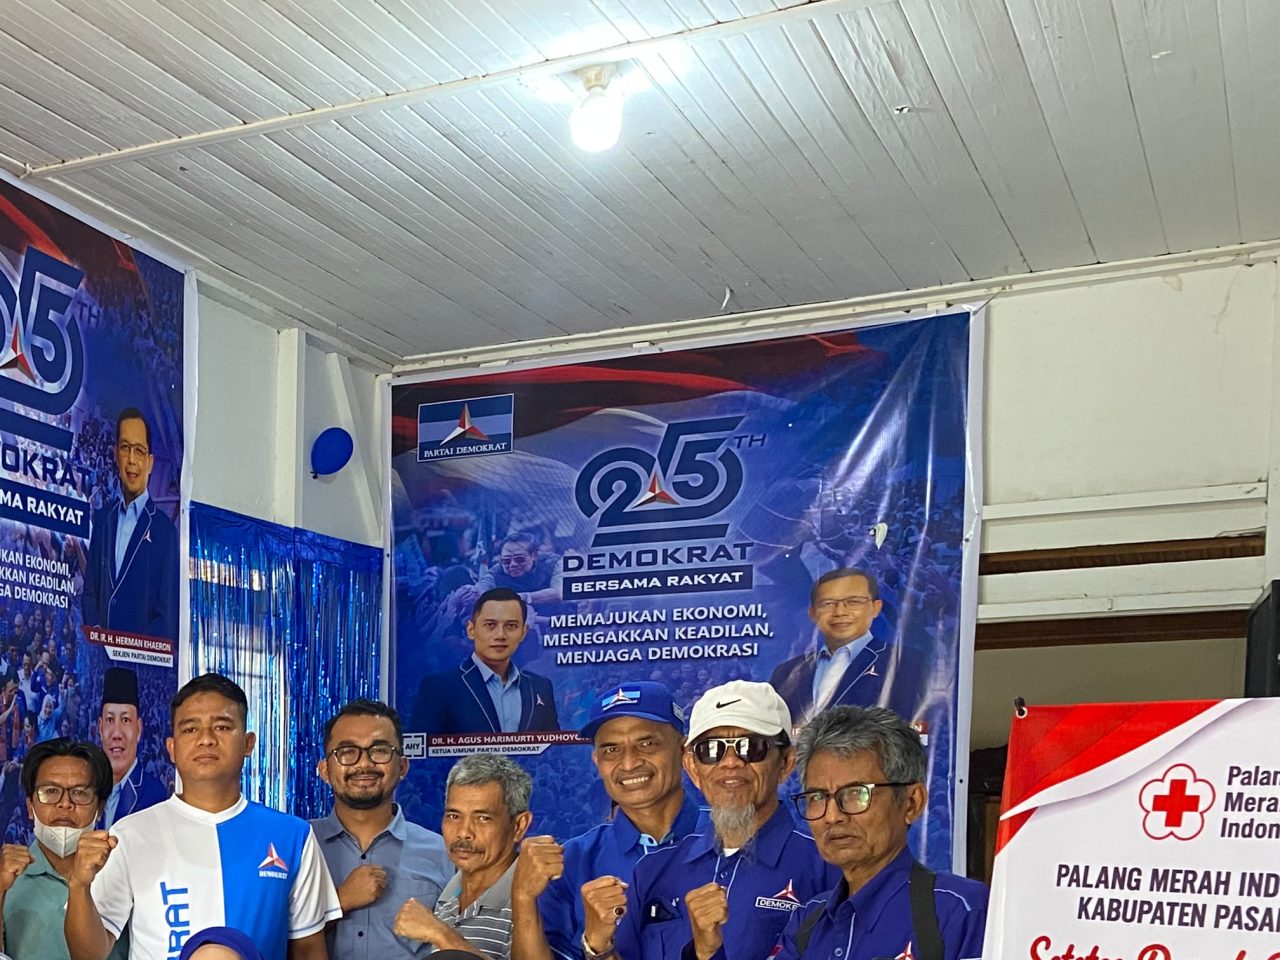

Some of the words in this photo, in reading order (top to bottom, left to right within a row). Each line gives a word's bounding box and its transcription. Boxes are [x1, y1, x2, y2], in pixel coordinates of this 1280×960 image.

[423, 445, 454, 459] PARTAI
[455, 442, 508, 457] DEMOKRAT
[26, 494, 84, 527] RAKYAT
[25, 555, 72, 580] EKONOMI,
[562, 541, 755, 574] DEMOKRAT
[28, 572, 77, 597] KEADILAN,
[570, 575, 662, 594] BERSAMA
[666, 571, 745, 589] RAKYAT
[14, 585, 69, 609] DEMOKRASI
[549, 608, 666, 629] MEMAJUKAN
[672, 603, 769, 624] EKONOMI,
[115, 636, 143, 648] HERMAN
[144, 640, 172, 652] KHAERON
[542, 626, 669, 648] MENEGAKKAN
[674, 621, 775, 643] KEADILAN,
[556, 646, 643, 665] MENJAGA
[647, 642, 760, 661] DEMOKRASI
[405, 742, 420, 751] AHY
[432, 737, 445, 746] DR.
[447, 737, 457, 745] H.
[458, 736, 482, 745] AGUS
[483, 734, 535, 744] HARIMURTI
[501, 744, 541, 753] DEMOKRAT
[1224, 792, 1280, 813] Mera
[1057, 864, 1141, 892] PALANG
[1149, 868, 1231, 897] MERAH
[1077, 896, 1206, 928] KABUPATEN
